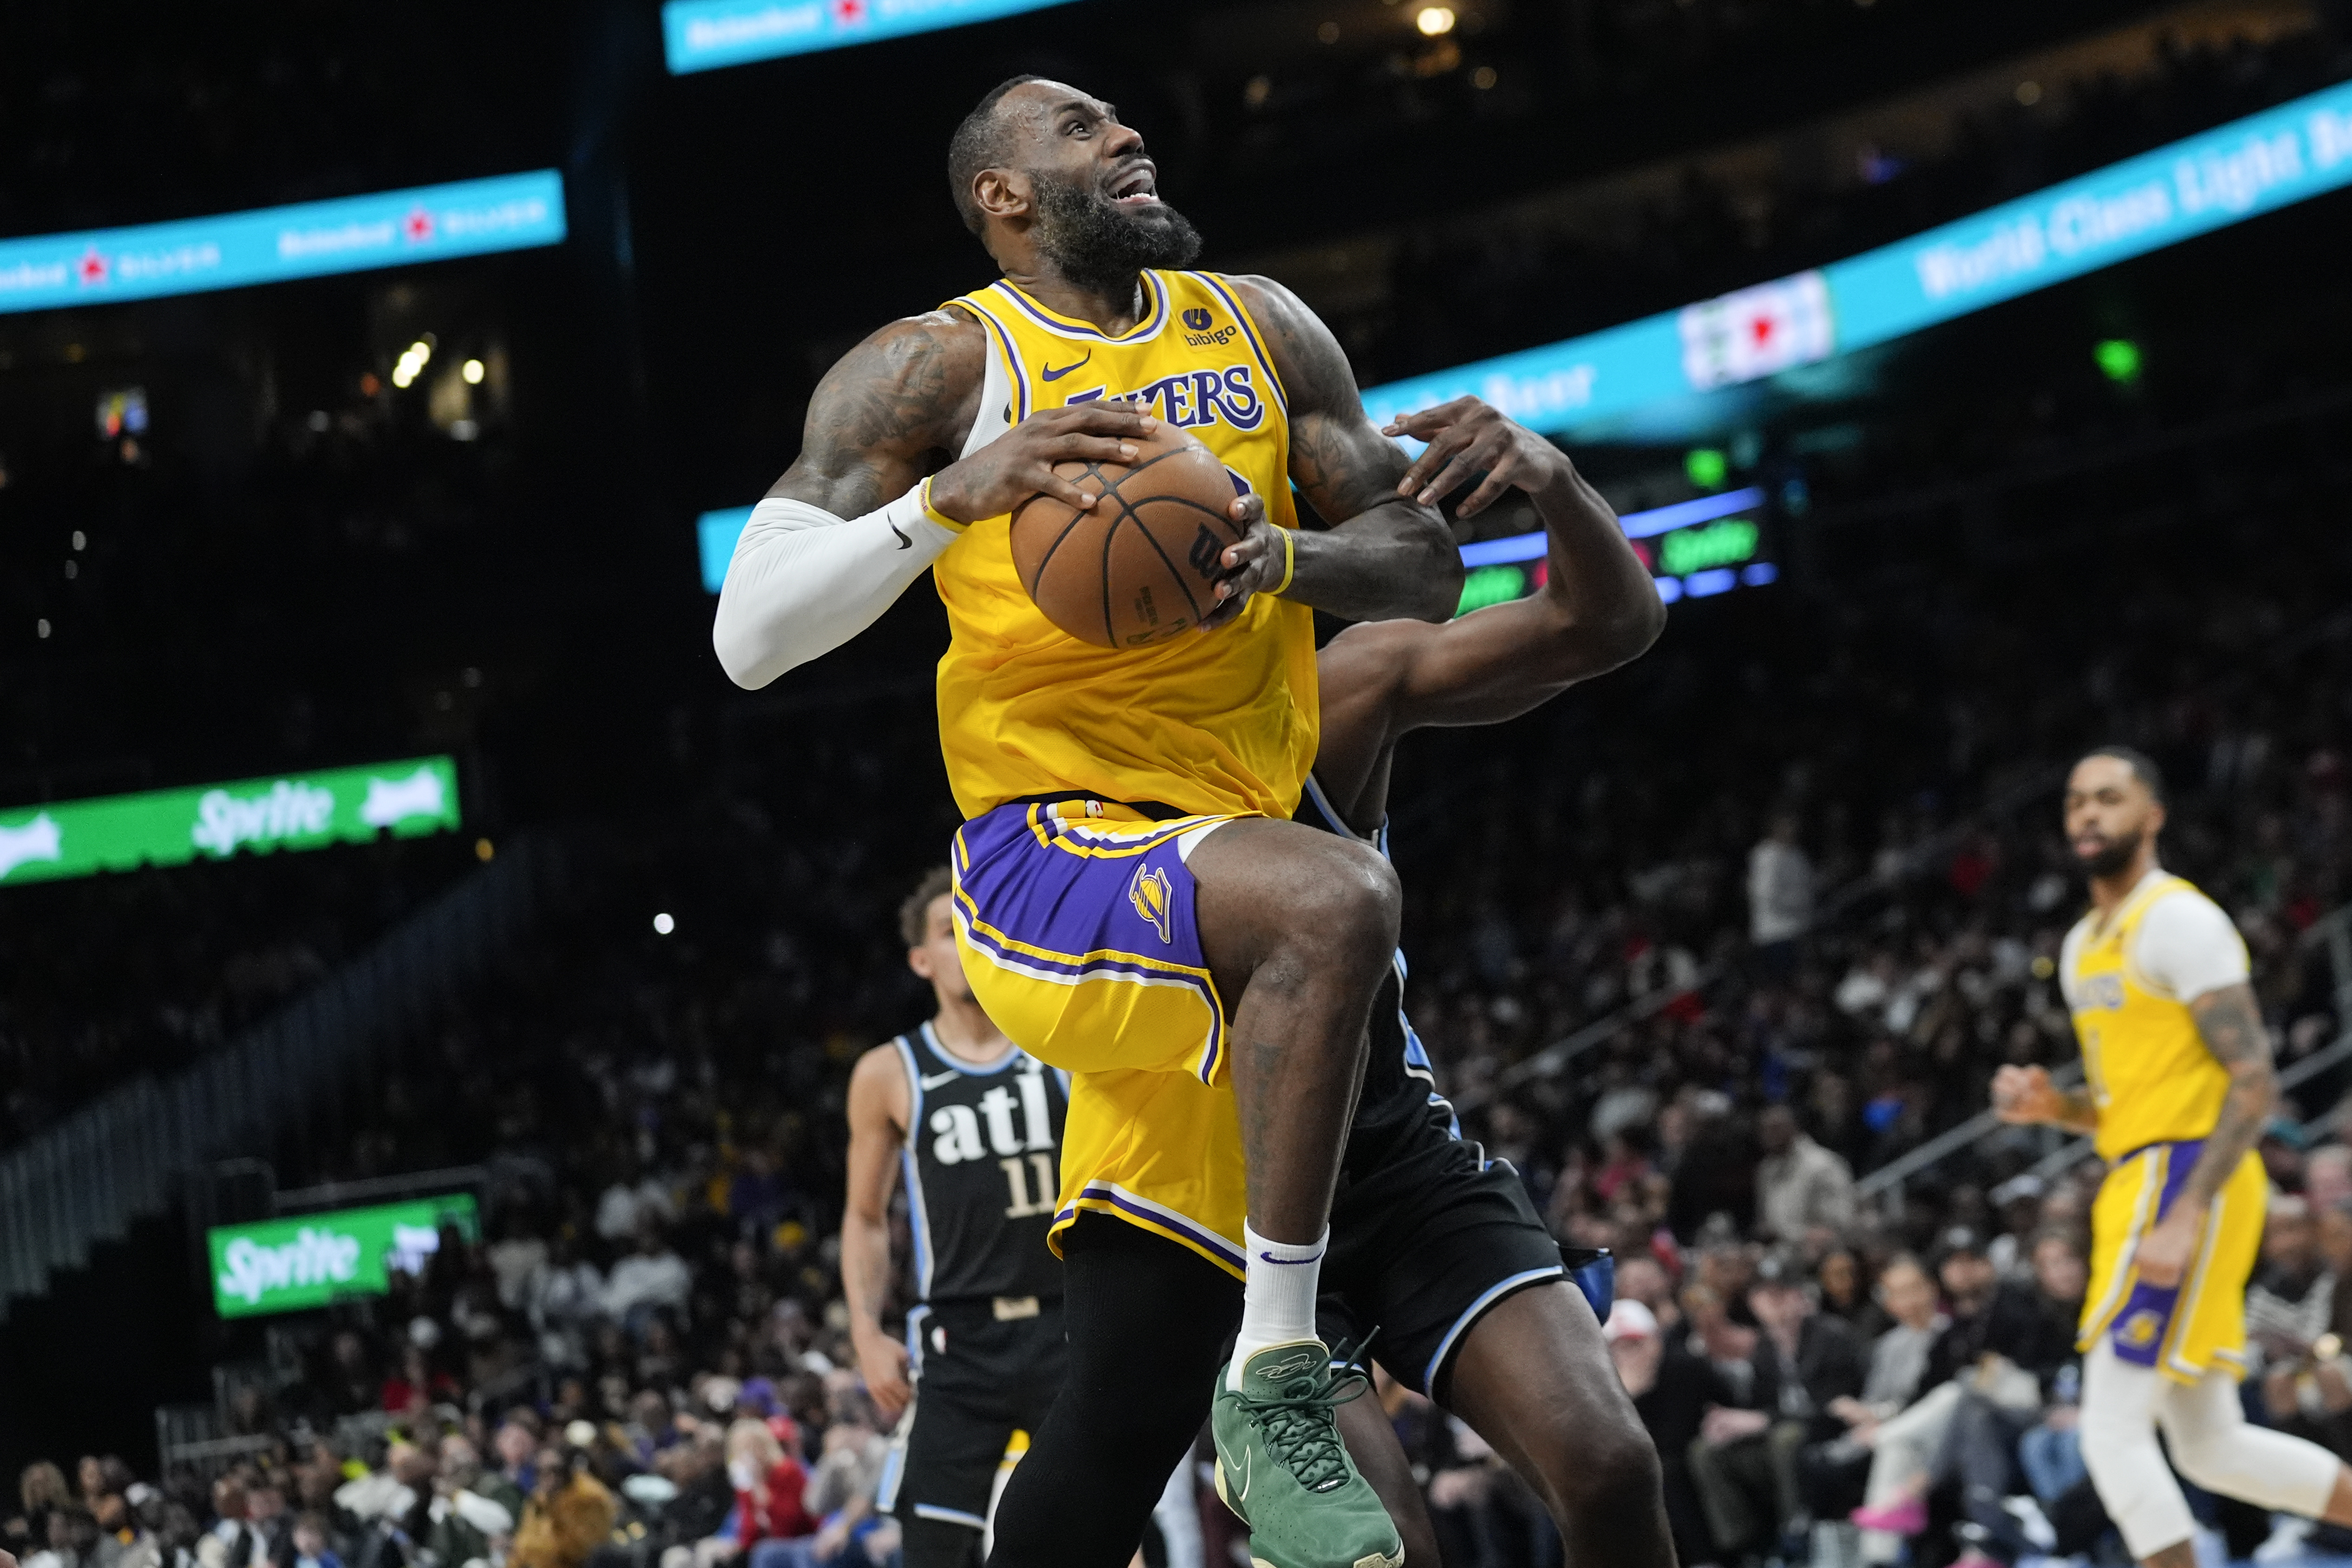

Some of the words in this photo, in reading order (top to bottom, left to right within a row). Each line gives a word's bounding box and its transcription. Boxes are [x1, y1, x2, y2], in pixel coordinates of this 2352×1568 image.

[1917, 217, 2043, 296] World
[2049, 183, 2168, 252] Class
[2176, 131, 2301, 212] Light
[1184, 325, 1237, 346] bibigo
[191, 779, 335, 856] Sprite
[929, 1072, 1057, 1166] atl
[999, 1152, 1057, 1219] 11
[218, 1225, 361, 1305] Sprite
